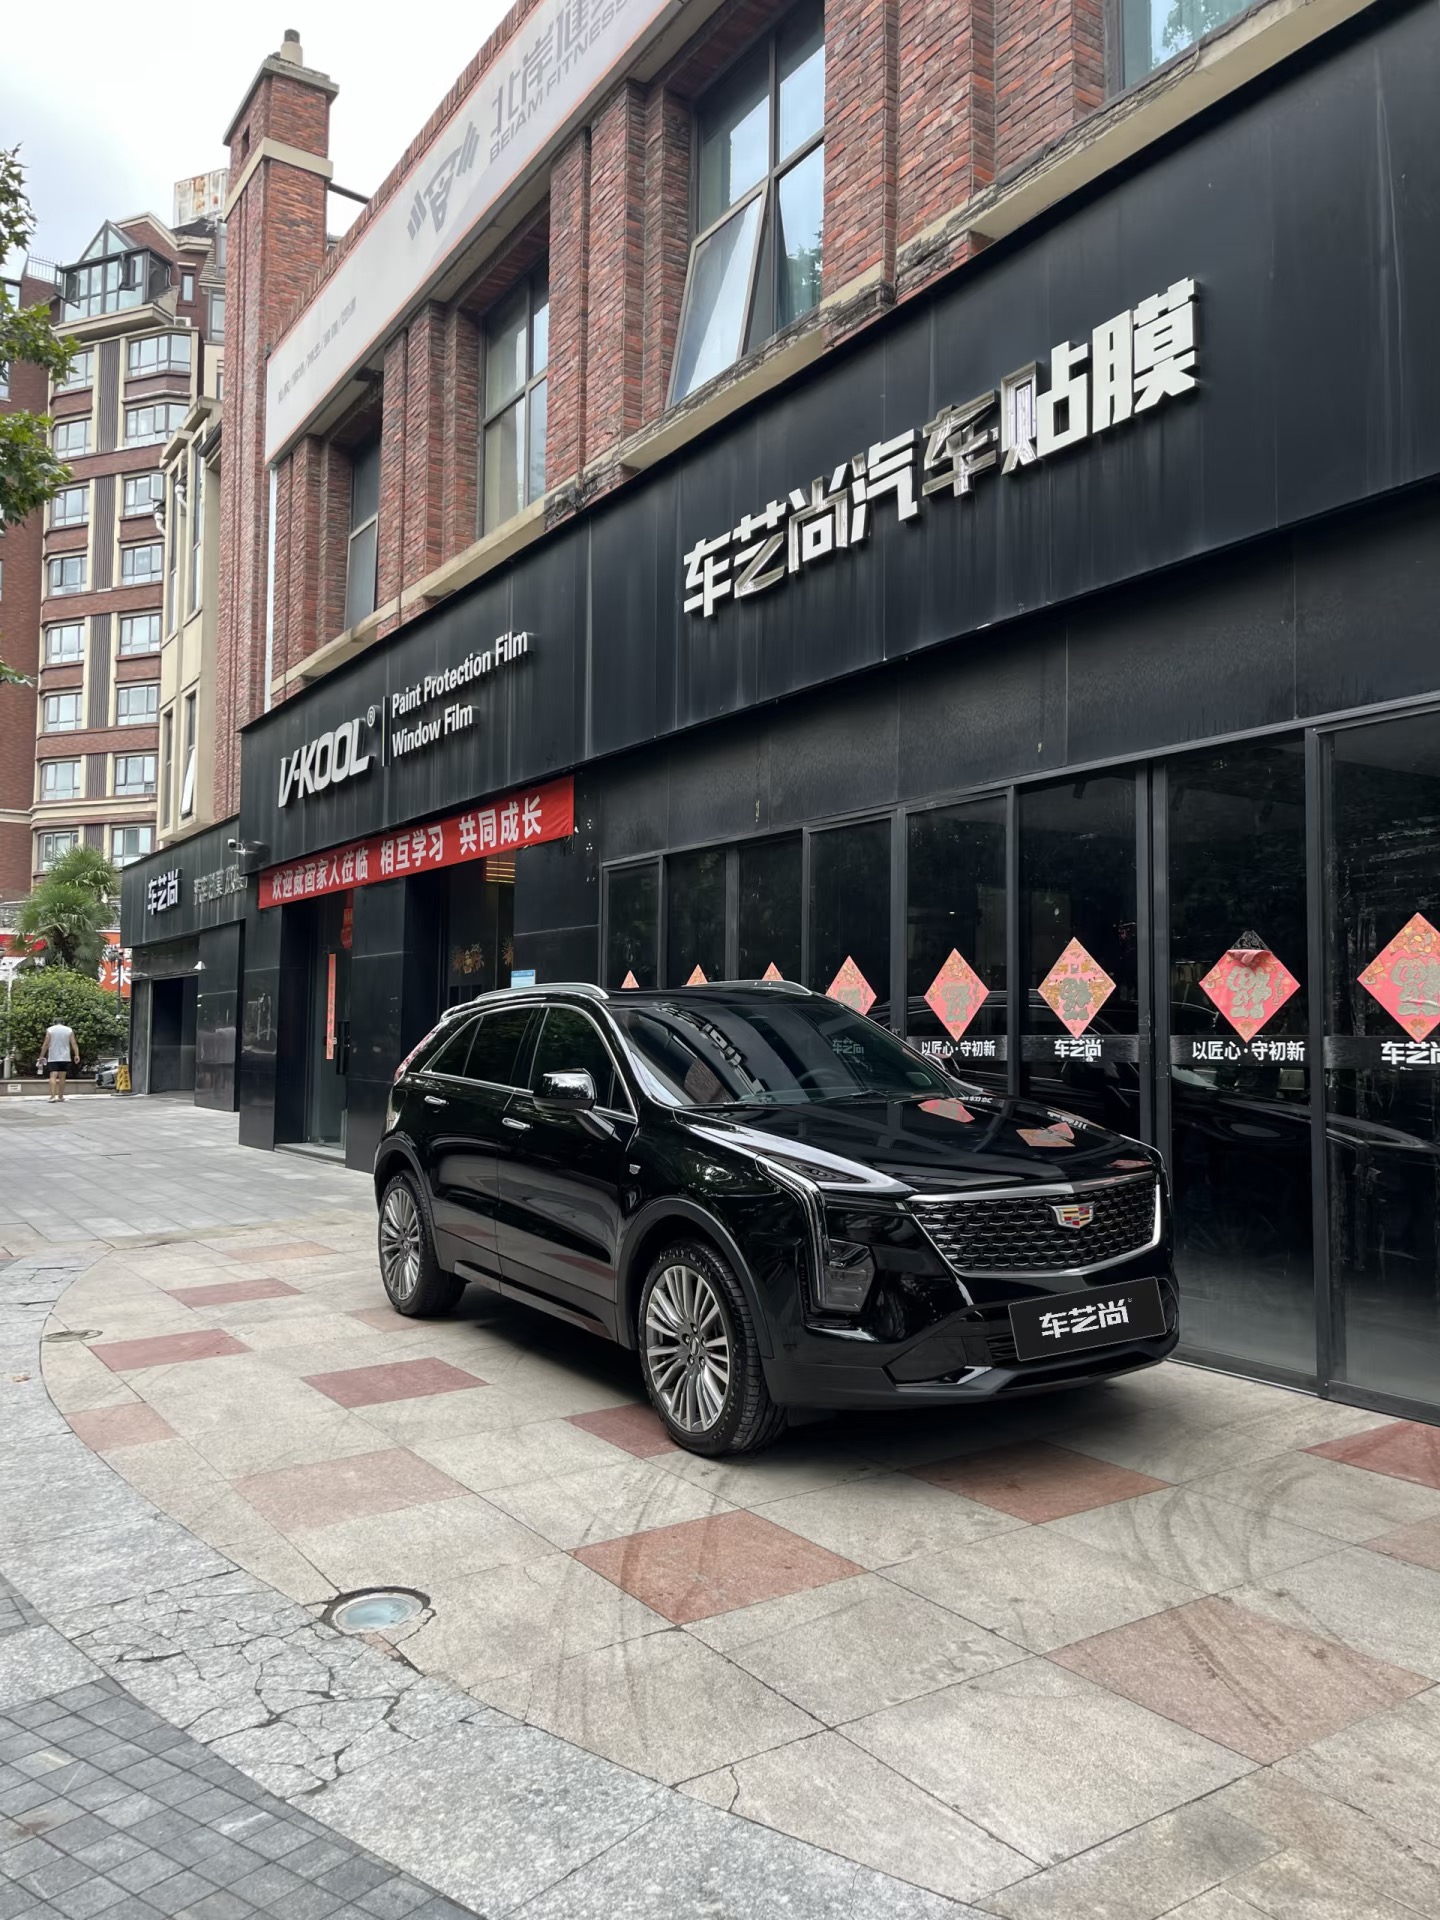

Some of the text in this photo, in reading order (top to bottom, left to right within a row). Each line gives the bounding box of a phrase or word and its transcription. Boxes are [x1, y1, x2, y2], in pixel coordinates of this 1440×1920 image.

[489, 87, 543, 165] BEIAM
[683, 277, 1200, 617] 车艺尚汽车贴膜
[392, 684, 421, 718] Paint
[424, 651, 491, 702] Protection
[495, 631, 528, 666] Film
[392, 703, 473, 757] Window Film
[271, 846, 369, 900] 欢迎威固家人莅临
[380, 825, 443, 875] 相互学习
[458, 796, 543, 855] 共同成长
[147, 868, 179, 916] 车艺尚
[1053, 1038, 1102, 1059] 车艺尚
[1039, 1299, 1130, 1338] 车艺尚
